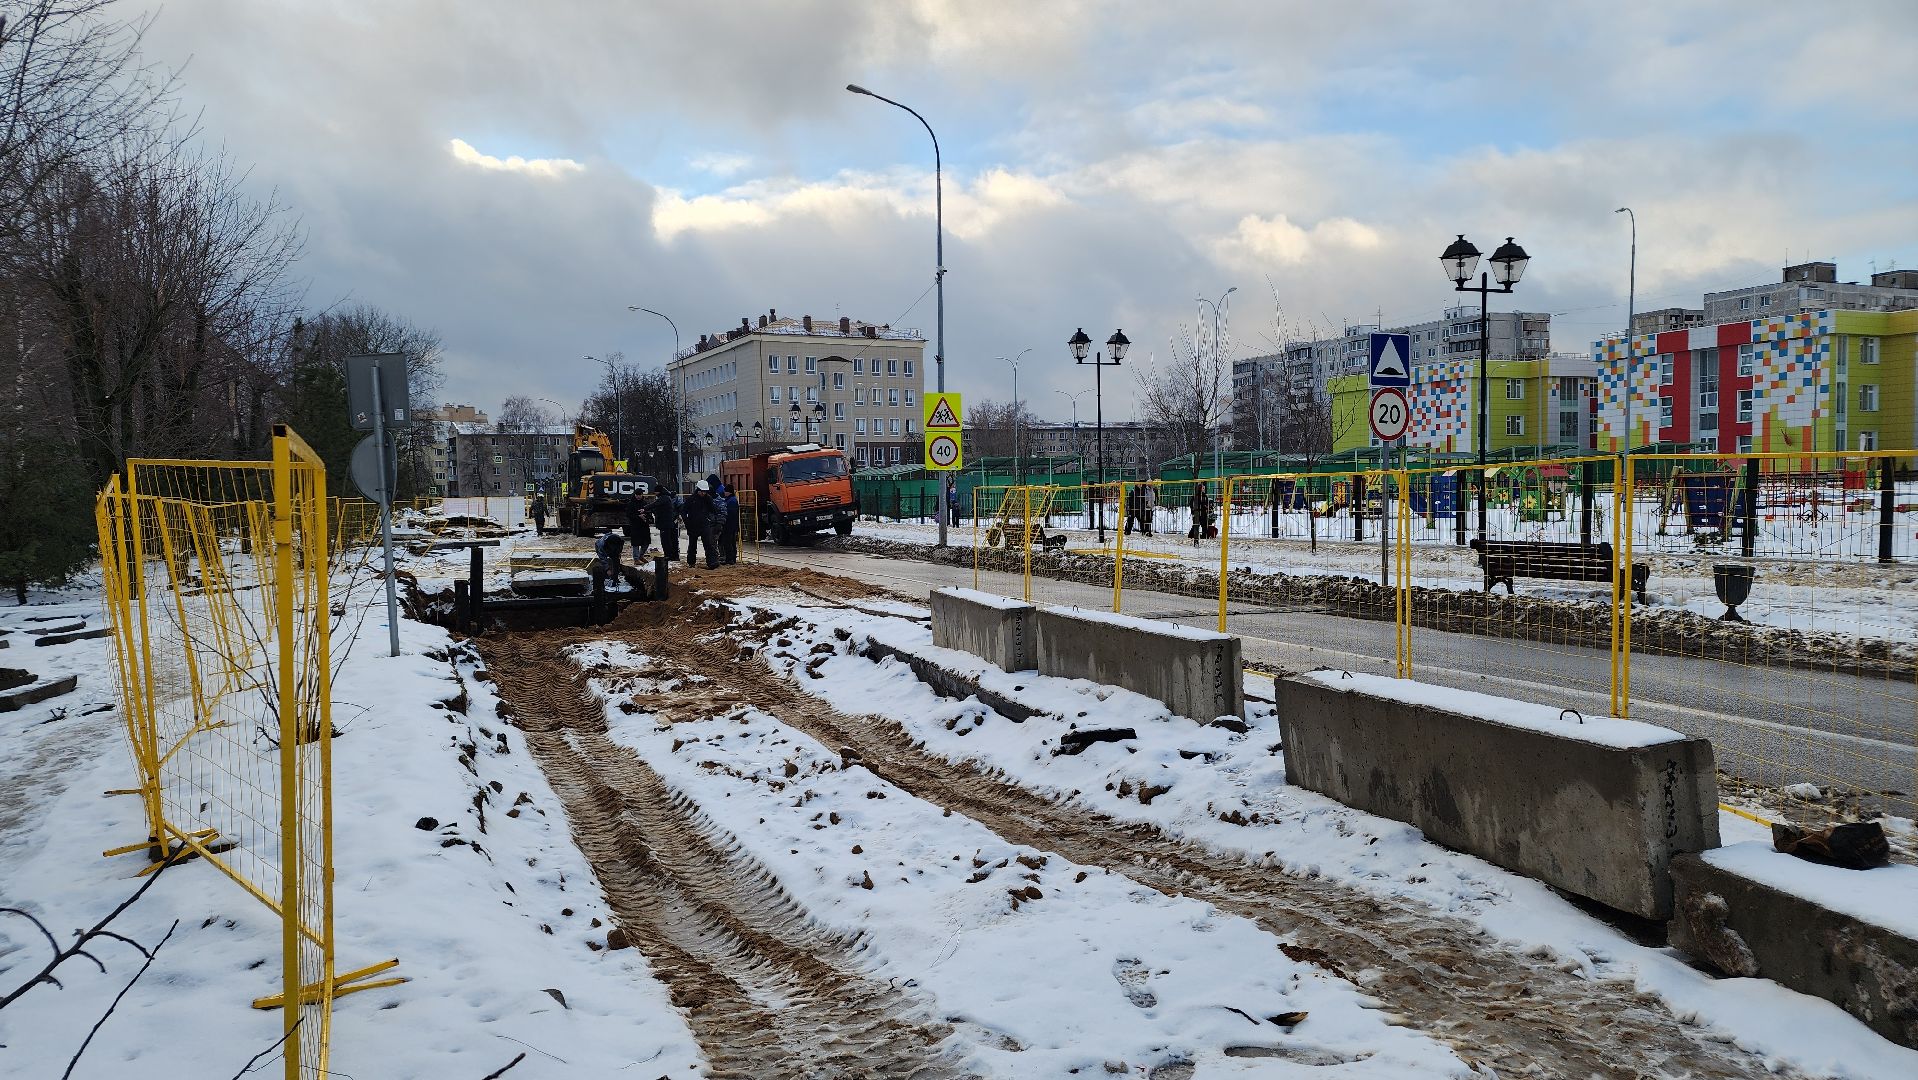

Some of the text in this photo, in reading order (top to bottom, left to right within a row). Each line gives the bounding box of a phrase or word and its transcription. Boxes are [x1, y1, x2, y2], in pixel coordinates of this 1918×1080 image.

[1379, 403, 1400, 424] 20
[937, 445, 951, 457] 40
[603, 480, 649, 495] JCB
